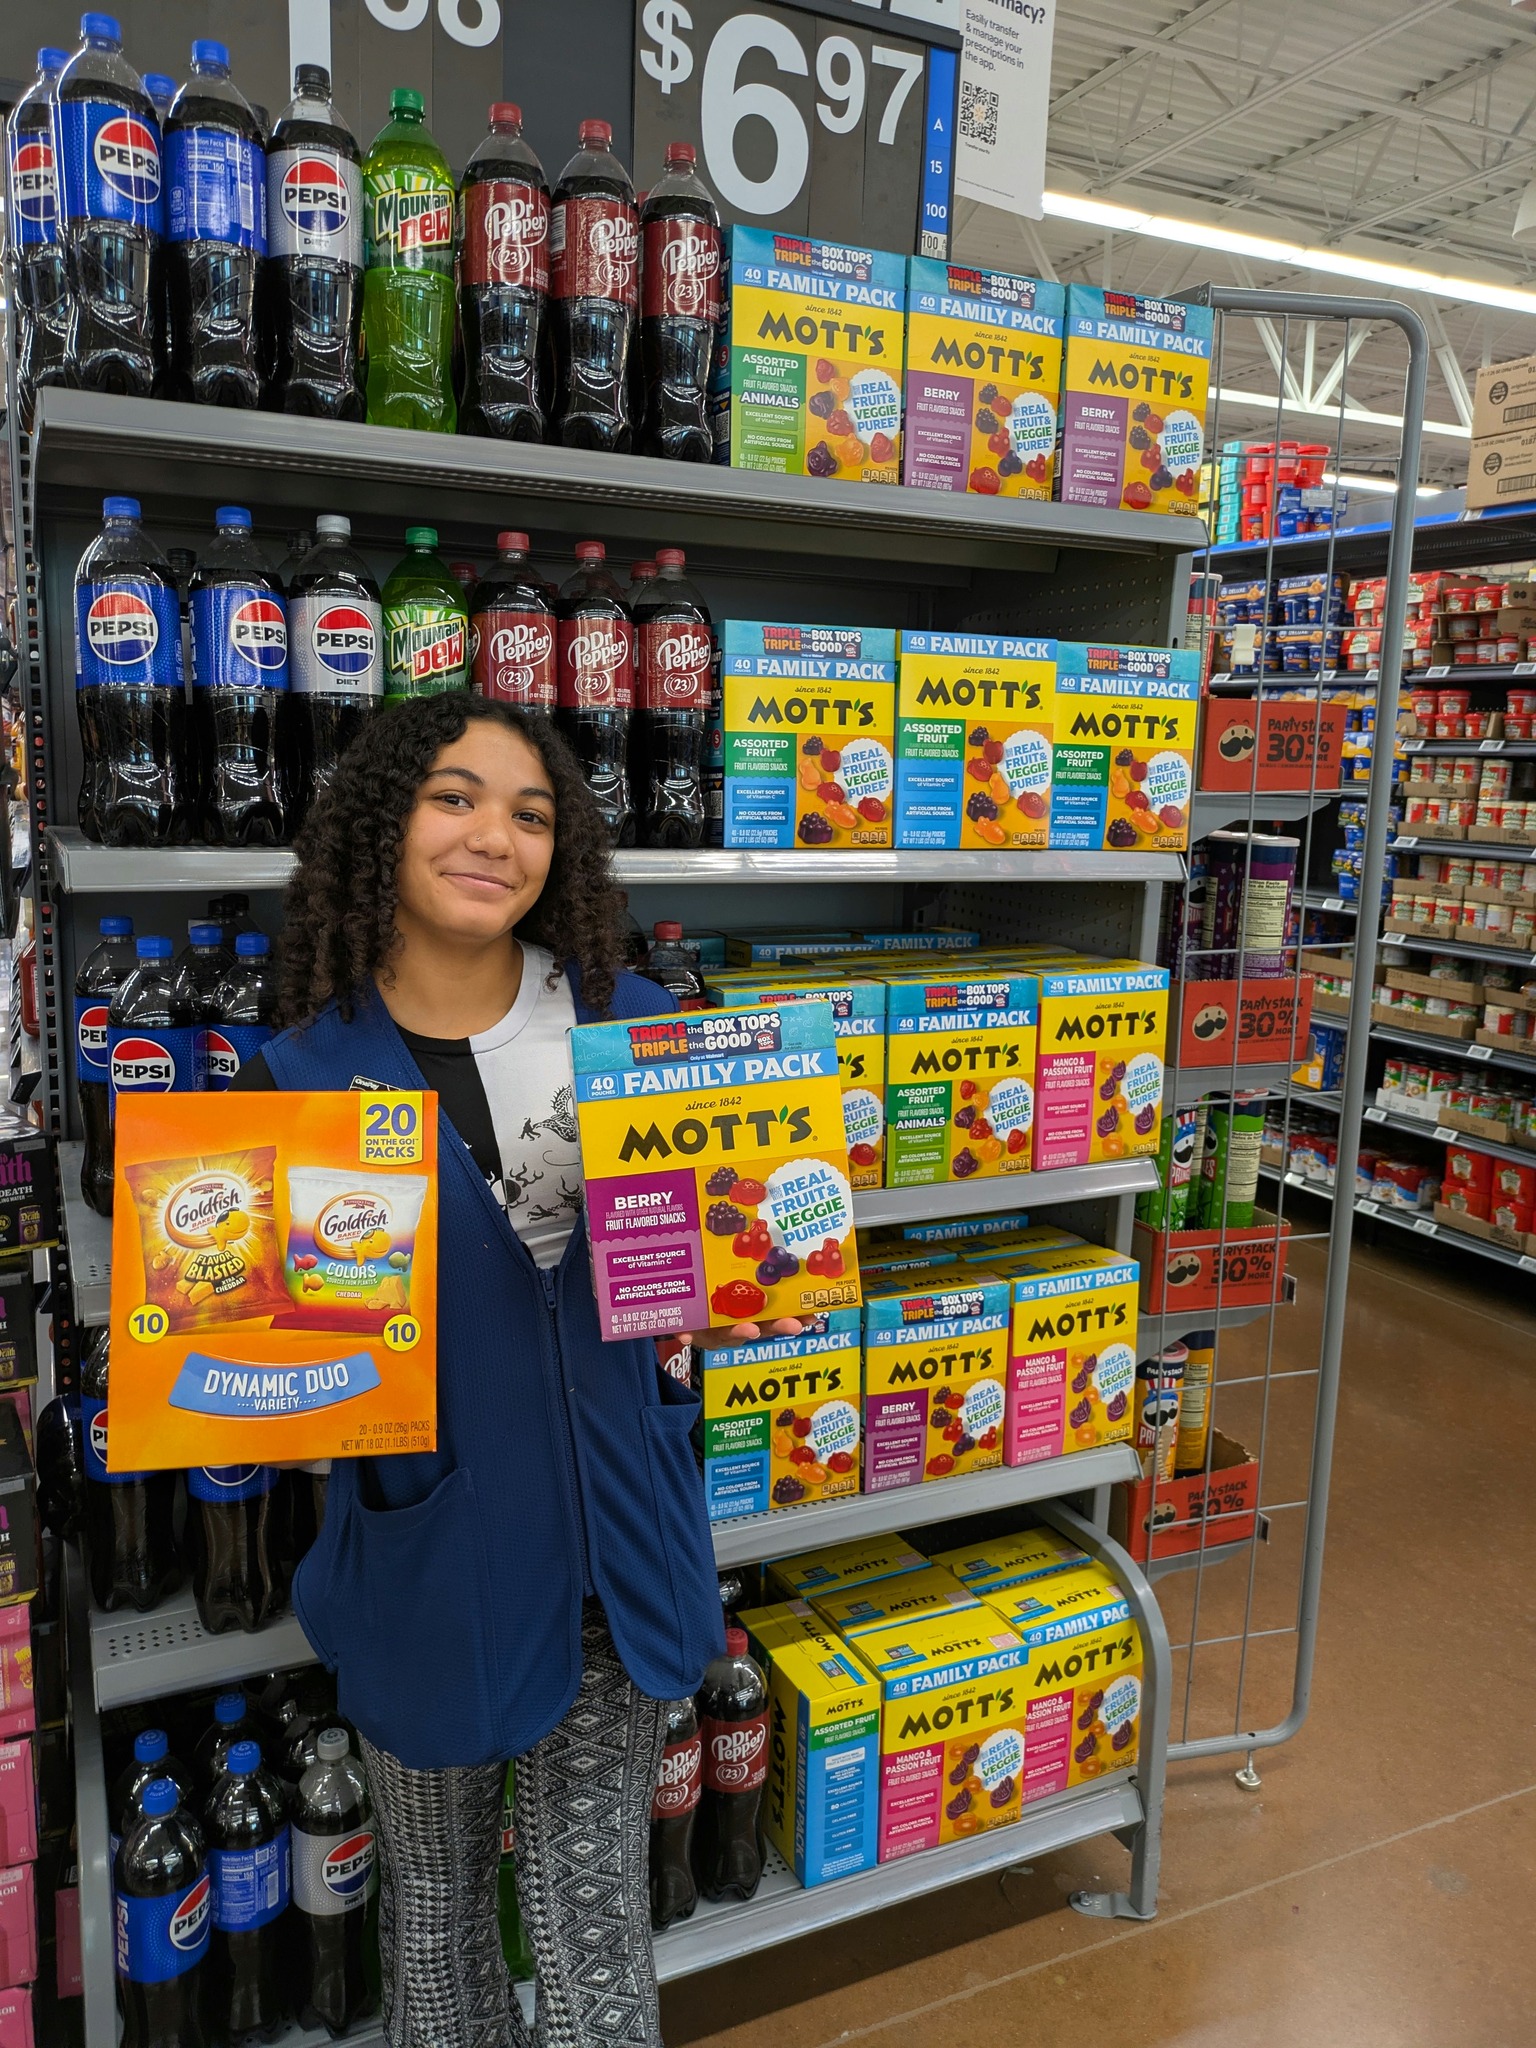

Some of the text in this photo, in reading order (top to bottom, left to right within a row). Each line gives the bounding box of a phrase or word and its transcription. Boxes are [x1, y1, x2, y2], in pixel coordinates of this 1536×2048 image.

[966, 9, 1020, 40] Easily transfer
[965, 23, 1023, 55] & manage your
[965, 38, 1024, 69] prescriptions in
[965, 51, 996, 72] the app.
[933, 118, 943, 132] A
[100, 145, 159, 180] PEPSI
[930, 160, 943, 174] 15
[284, 187, 346, 211] PEPSI
[510, 198, 534, 218] Dr
[926, 203, 947, 219] 100
[492, 202, 546, 241] Pepper
[767, 269, 897, 309] FAMILY PACK
[757, 309, 885, 356] MOTT'S
[930, 336, 1044, 380] MOTT'S
[1088, 358, 1193, 399] MOTT'S
[740, 391, 800, 409] ANIMALS
[924, 387, 960, 401] BERRY
[90, 621, 154, 638] PEPSI
[515, 624, 537, 642] Dr
[316, 632, 374, 651] PEPSI
[490, 629, 549, 663] Pepper
[507, 671, 522, 685] 23
[757, 658, 885, 681] FAMILY PACK
[336, 678, 360, 686] DIET
[1080, 677, 1190, 699] FAMILY PACK
[916, 676, 1041, 710] MOTT'S
[747, 696, 874, 727] MOTT'S
[903, 723, 962, 735] ASSORTED
[1070, 711, 1179, 741] MOTT'S
[917, 733, 949, 744] FRUIT
[1067, 974, 1163, 994] FAMILY PACK
[630, 1012, 781, 1040] TRIPLE the BOX TOPS
[1055, 1010, 1157, 1041] MOTT'S
[630, 1032, 751, 1058] TRIPLE the GOOD
[910, 1043, 1020, 1076] MOTT'S
[113, 1064, 170, 1079] PEPSI
[590, 1077, 614, 1091] 40
[624, 1062, 740, 1095] FAMILY
[745, 1052, 824, 1082] PACK
[591, 1089, 616, 1097] POUCHES
[685, 1096, 742, 1111] since 1842
[365, 1103, 417, 1136] 20
[365, 1138, 380, 1146] ON
[618, 1105, 813, 1163] MOTT'S
[365, 1146, 415, 1159] PACKS
[782, 1169, 832, 1198] REAL
[176, 1189, 242, 1223] Goldfish
[614, 1191, 673, 1210] BERRY
[191, 1213, 217, 1229] BAKED
[324, 1209, 389, 1236] Goldfish
[605, 1211, 686, 1231] FRUIT FLAVORED SNACKS
[775, 1196, 845, 1232] VEGGIE
[337, 1230, 362, 1240] BAKED
[196, 1251, 235, 1267] FLAVOR
[613, 1249, 686, 1264] EXCELLENT SOURCE
[636, 1259, 665, 1267] Vitamin
[666, 1257, 672, 1265] C
[185, 1256, 245, 1282] BLASTED
[326, 1262, 378, 1279] COLORS
[1247, 1272, 1270, 1281] MORE
[214, 1276, 246, 1294] CHEDDAR
[221, 1277, 236, 1286] XTRA
[619, 1279, 685, 1294] NO COLORS FROM
[1038, 1267, 1133, 1297] FAMILY PACK
[336, 1291, 362, 1299] CHEDDAR
[615, 1285, 691, 1301] ARTIFICIAL SOURCES
[659, 1306, 682, 1317] POUCHES
[132, 1313, 164, 1334] 10
[612, 1323, 622, 1334] NET
[623, 1322, 632, 1333] WT
[637, 1320, 647, 1331] LBS
[1027, 1302, 1126, 1343] MOTT'S
[388, 1323, 416, 1343] 10
[887, 1347, 993, 1385] MOTT'S
[203, 1363, 349, 1397] DYNAMIC DUO
[725, 1368, 841, 1408] MOTT'S
[254, 1397, 300, 1411] VARIETY
[359, 1420, 430, 1435] 20 0.9 OZ (26g) PACKS
[341, 1439, 353, 1451] NET
[353, 1438, 365, 1450] WT
[365, 1438, 375, 1449] 18
[375, 1437, 384, 1449] OZ
[411, 1435, 430, 1448] (510g)
[911, 1651, 1021, 1693] FAMILY PACK
[1034, 1636, 1134, 1688] MOTT'S
[898, 1688, 1015, 1740] MOTT'S
[714, 1729, 763, 1763] Pepper
[734, 1730, 752, 1747] Dr
[886, 1754, 942, 1776] PASSION FRUIT
[896, 1750, 932, 1764] MANGO &
[117, 1898, 130, 1973] PEPSI
